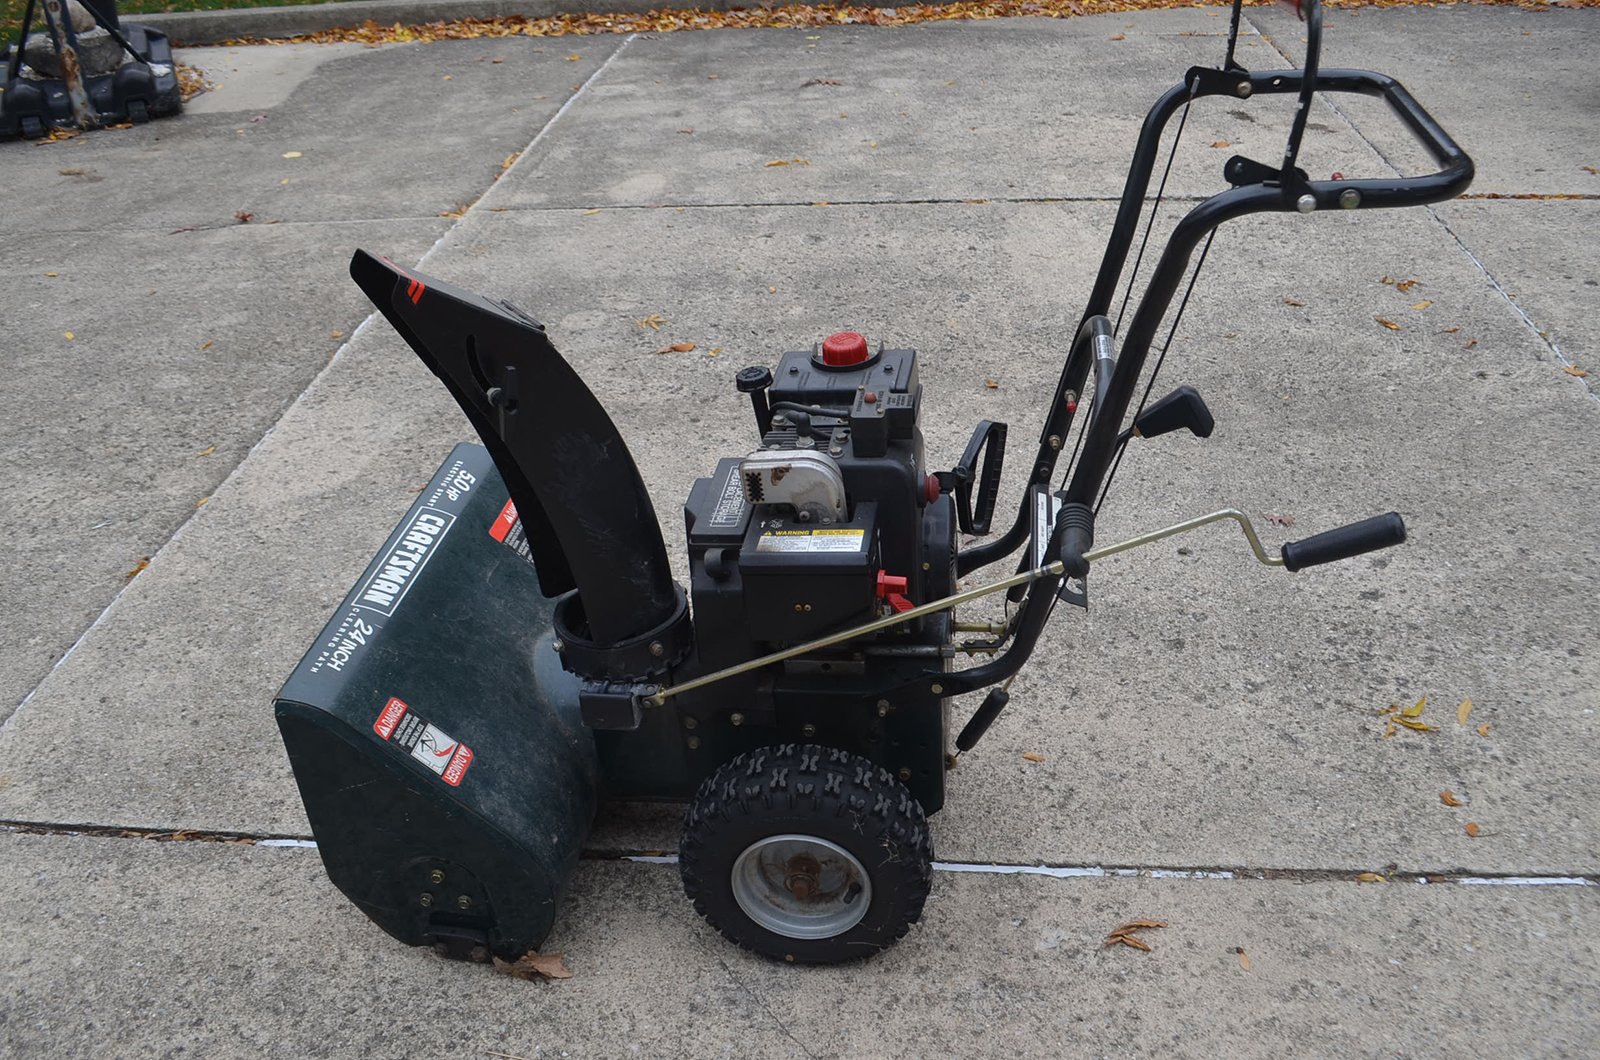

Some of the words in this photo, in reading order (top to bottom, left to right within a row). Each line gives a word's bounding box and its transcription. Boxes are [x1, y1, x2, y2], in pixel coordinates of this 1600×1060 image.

[441, 460, 464, 487] ELECTRIC
[454, 469, 476, 491] 5.0
[427, 488, 444, 507] START
[446, 486, 461, 501] HP
[725, 486, 737, 500] BOLT
[363, 513, 446, 607] CRAFTSMAN
[328, 608, 360, 648] CLEARING
[348, 618, 373, 645] 24
[310, 651, 330, 673] PATH
[327, 638, 358, 671] INCH
[381, 700, 406, 729] DANGER
[444, 757, 467, 783] DANGER
